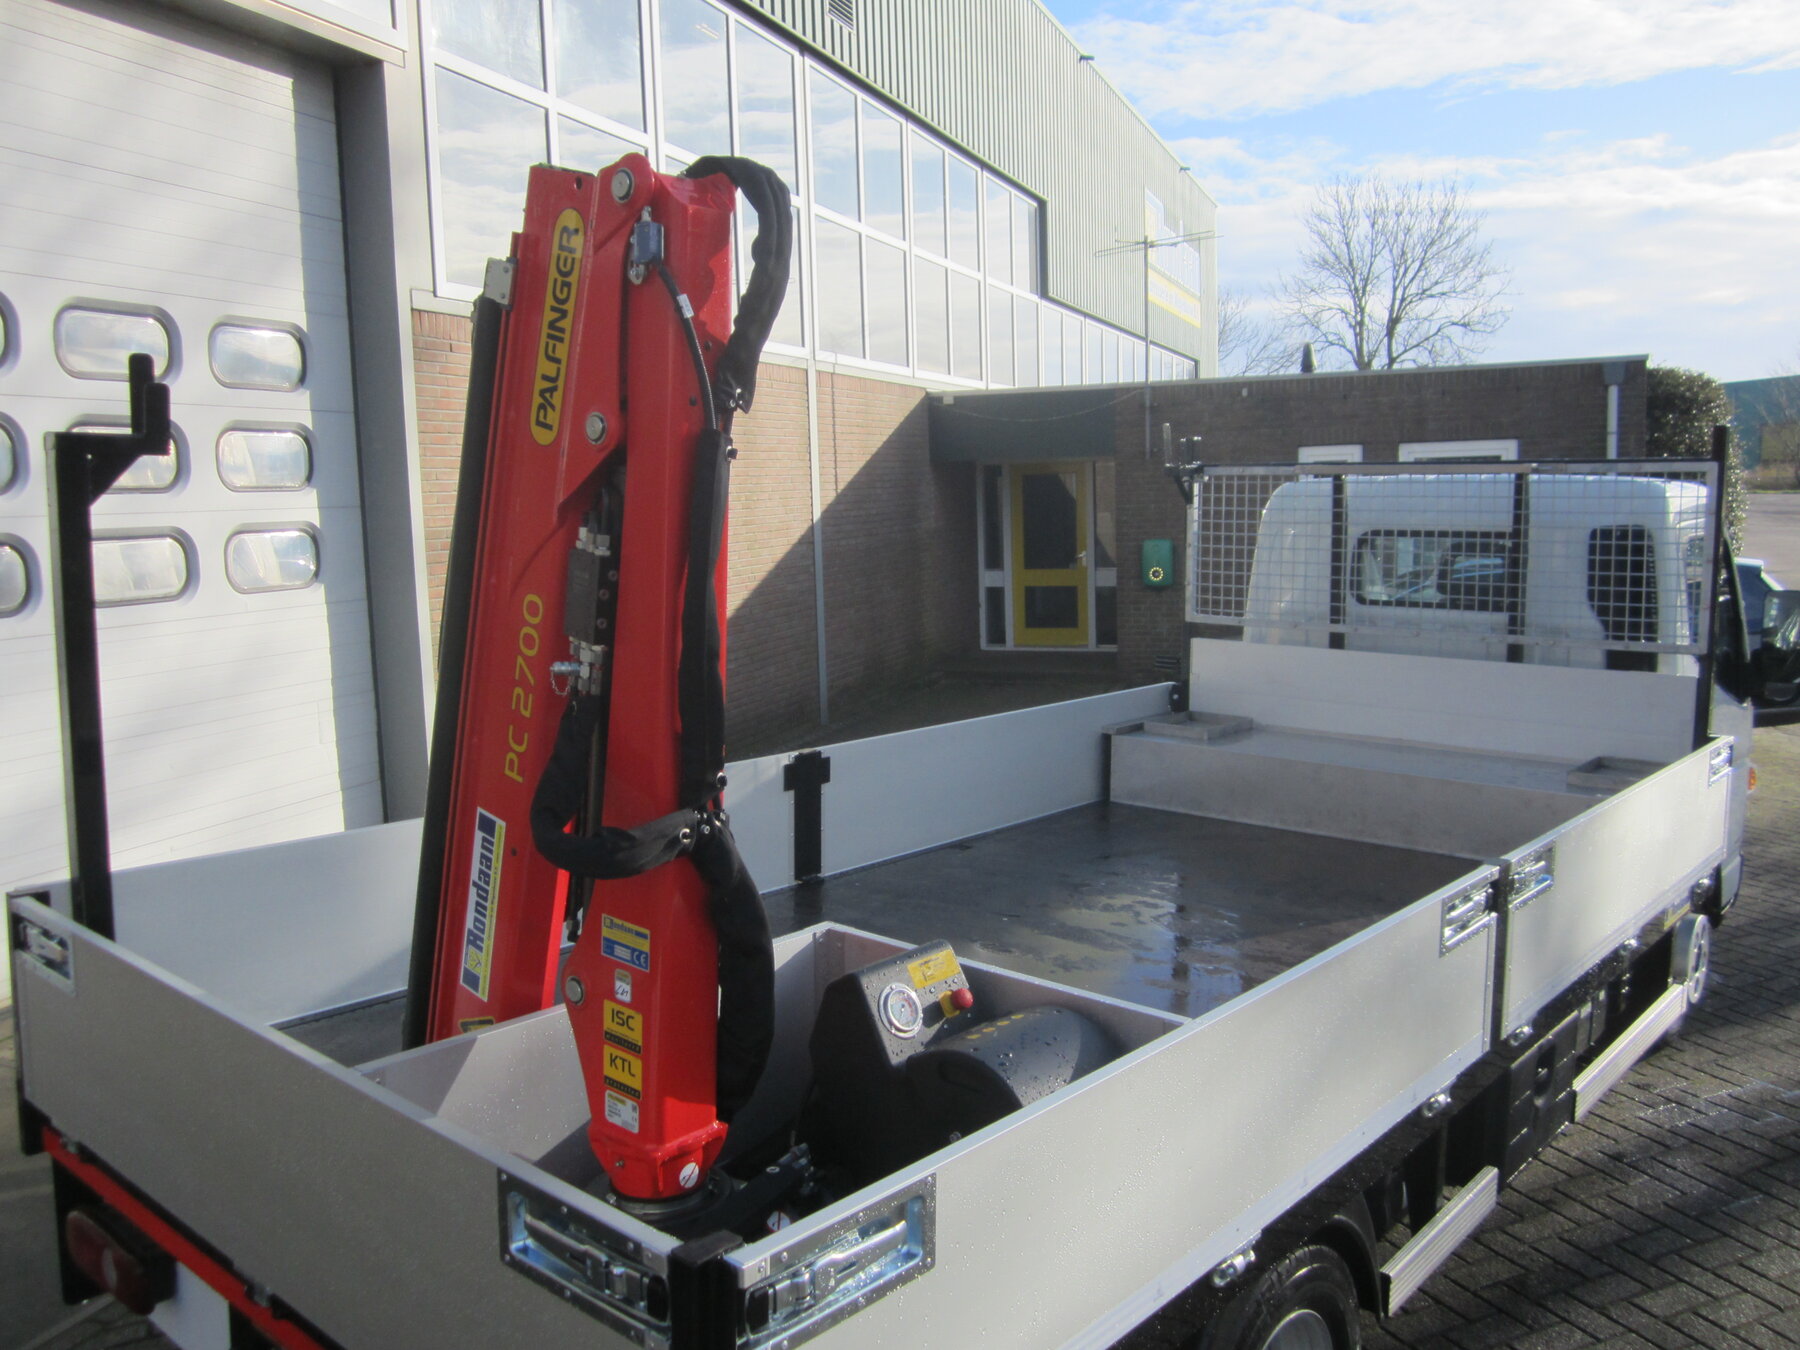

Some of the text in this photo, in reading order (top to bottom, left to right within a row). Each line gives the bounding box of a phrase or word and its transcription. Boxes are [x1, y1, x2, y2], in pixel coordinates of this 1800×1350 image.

[534, 224, 580, 432] PALFINGER
[504, 593, 544, 784] PC 2700
[466, 835, 496, 954] Rondaan
[609, 1052, 637, 1078] KTL
[611, 1007, 636, 1032] ISC
